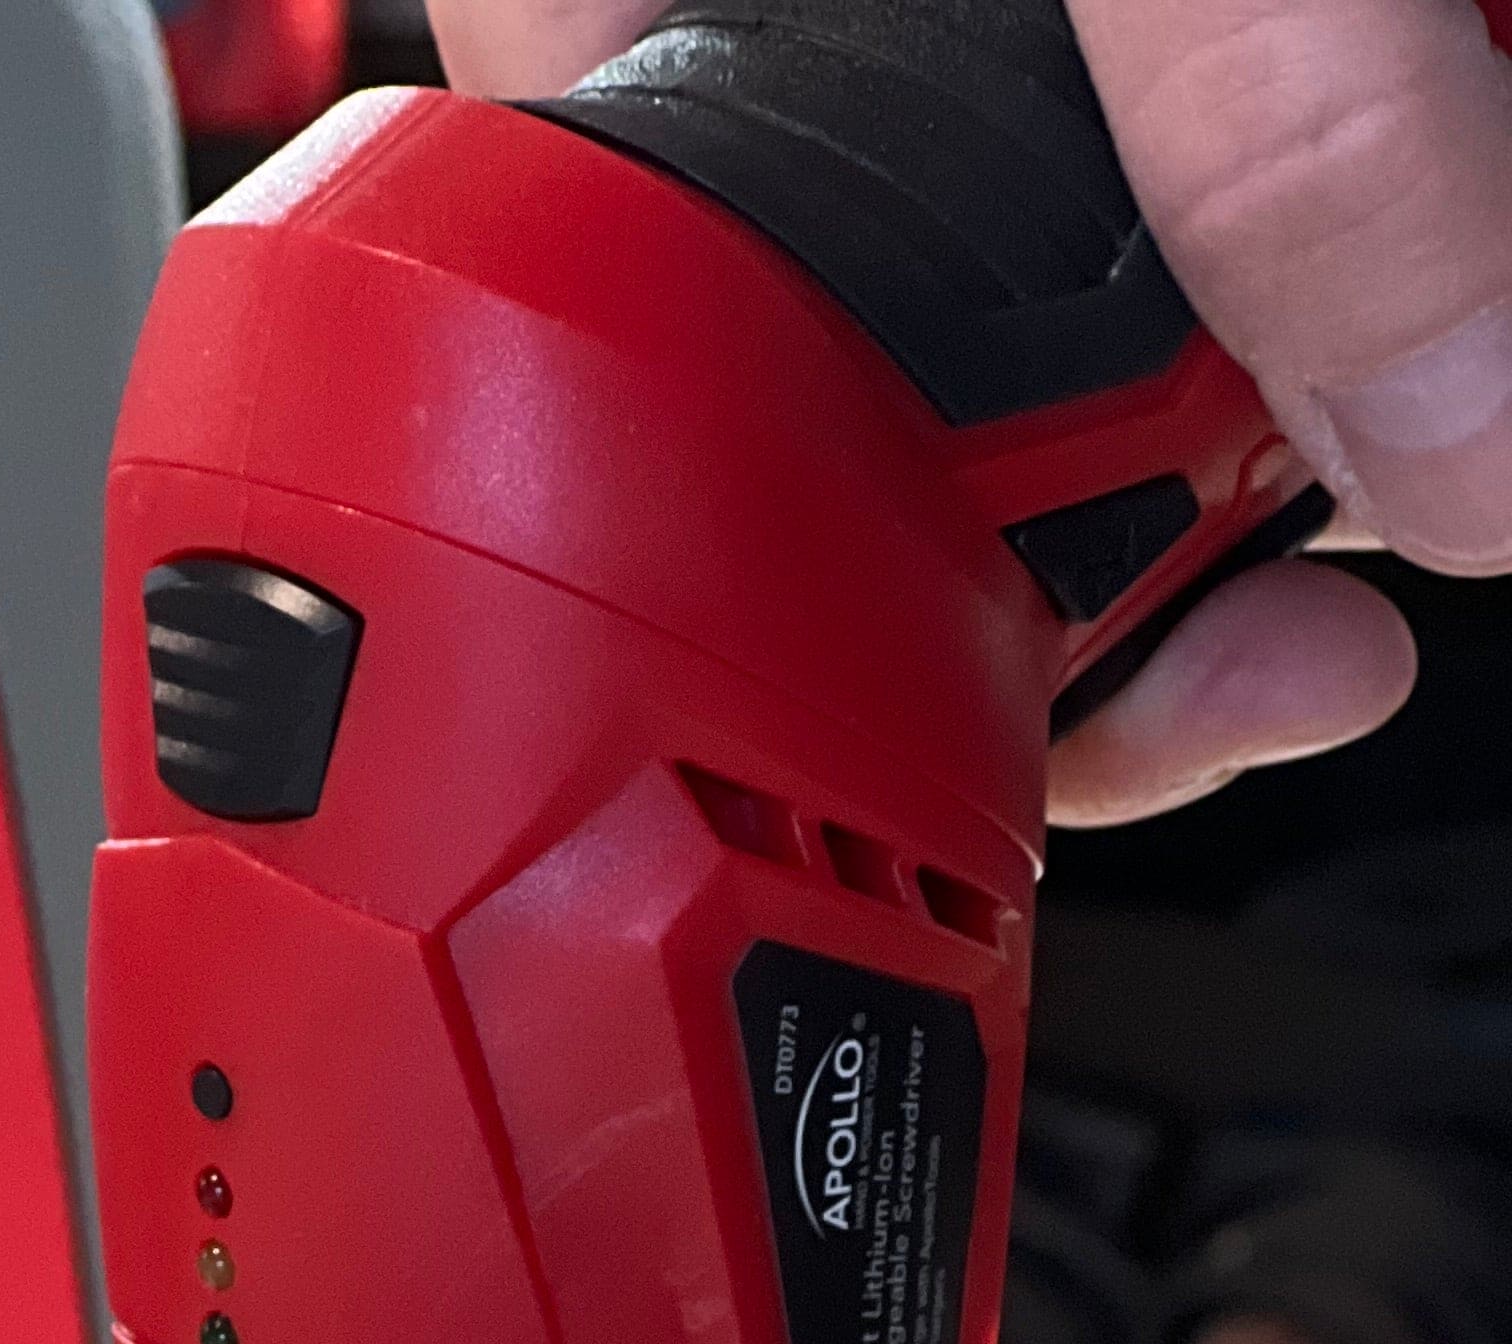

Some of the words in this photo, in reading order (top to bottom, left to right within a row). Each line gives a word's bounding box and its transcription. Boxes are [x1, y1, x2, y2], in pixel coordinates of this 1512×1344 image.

[774, 1005, 799, 1094] DT0773
[823, 1039, 863, 1230] APOLLO
[893, 1024, 925, 1223] Screwdriver
[860, 1130, 895, 1318] Lithium-Ion
